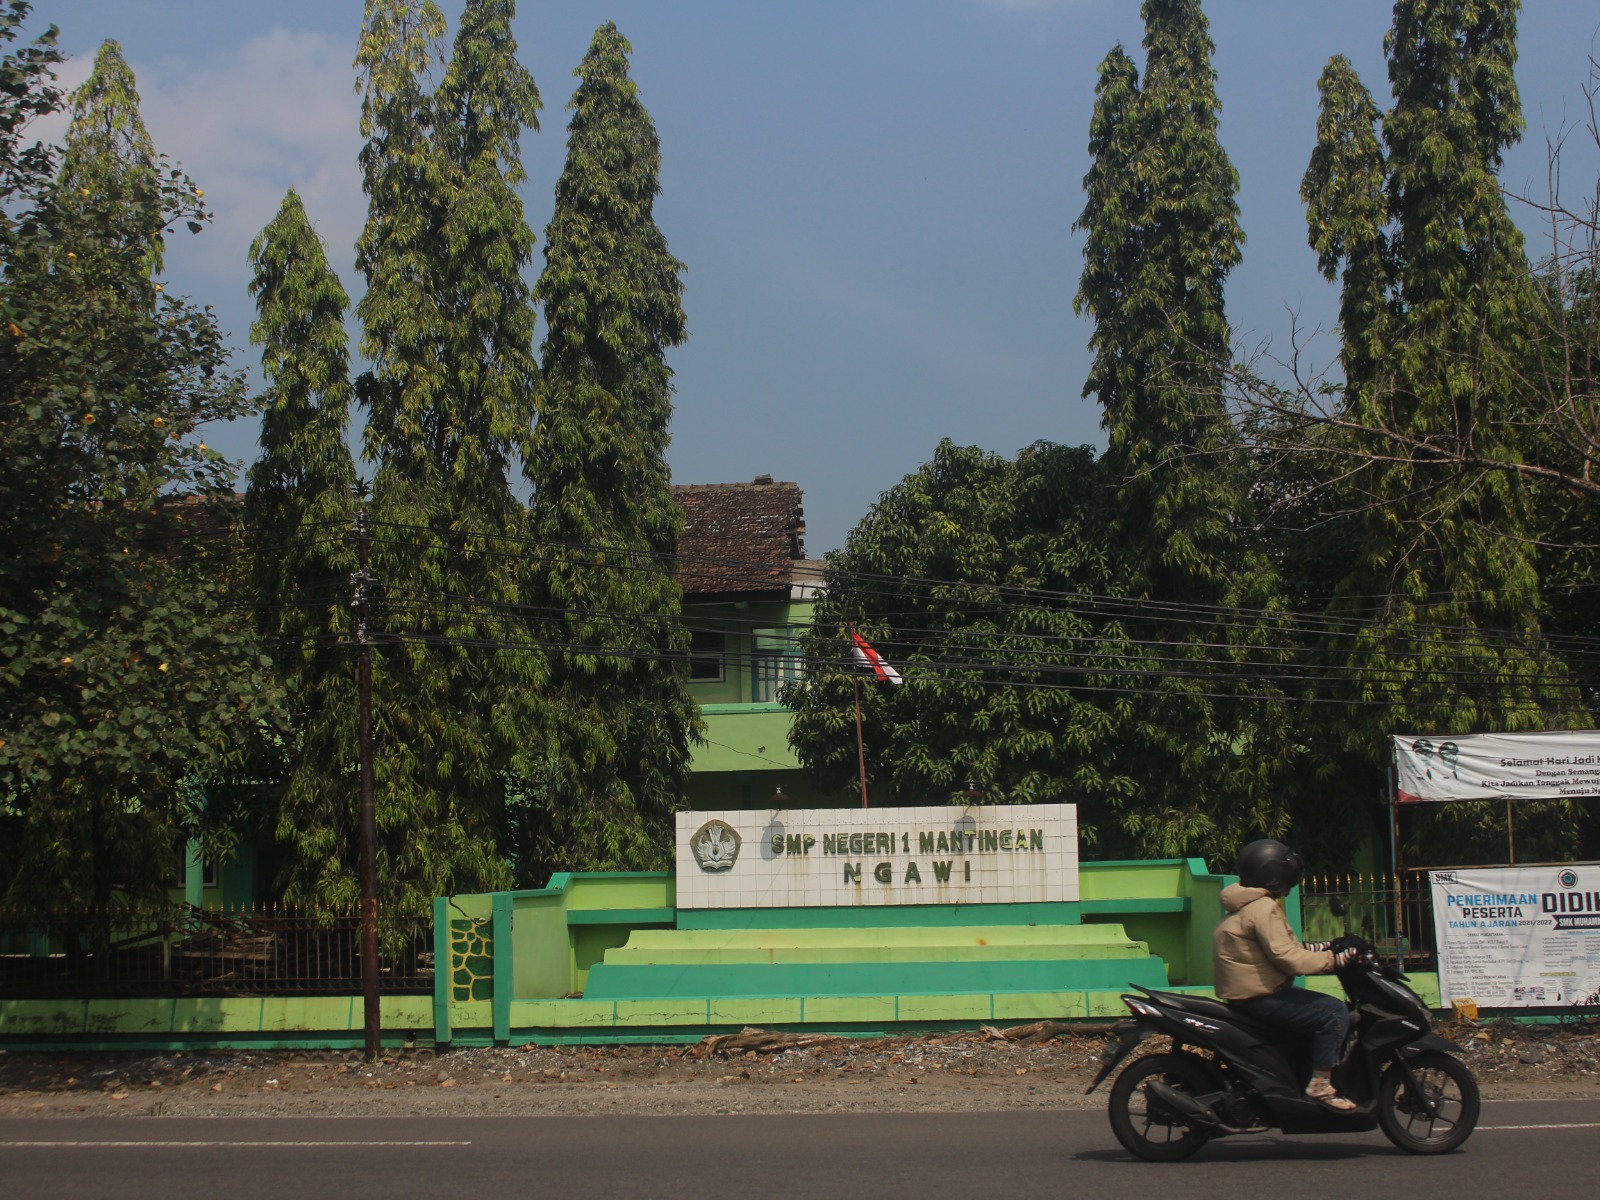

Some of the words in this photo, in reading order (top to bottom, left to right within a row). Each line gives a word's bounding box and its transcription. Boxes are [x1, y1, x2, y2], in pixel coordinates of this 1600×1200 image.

[1500, 758, 1543, 767] Selamat
[1546, 756, 1569, 765] Hari
[1573, 755, 1595, 764] Jadi
[1535, 769, 1566, 777] Dengan
[1567, 768, 1600, 776] Semang
[1536, 779, 1570, 787] Tonggak
[1559, 787, 1590, 796] Menuju
[771, 833, 816, 856] SMP
[823, 832, 896, 855] NEGERI
[901, 831, 911, 853] 1
[919, 828, 1044, 852] MANTINGAN
[843, 860, 972, 884] NGAWI
[1447, 893, 1537, 907] PENERIMAAN
[1462, 906, 1523, 919] PESERTA
[1448, 920, 1477, 928] TAHUN
[1480, 919, 1518, 928] AJARAN
